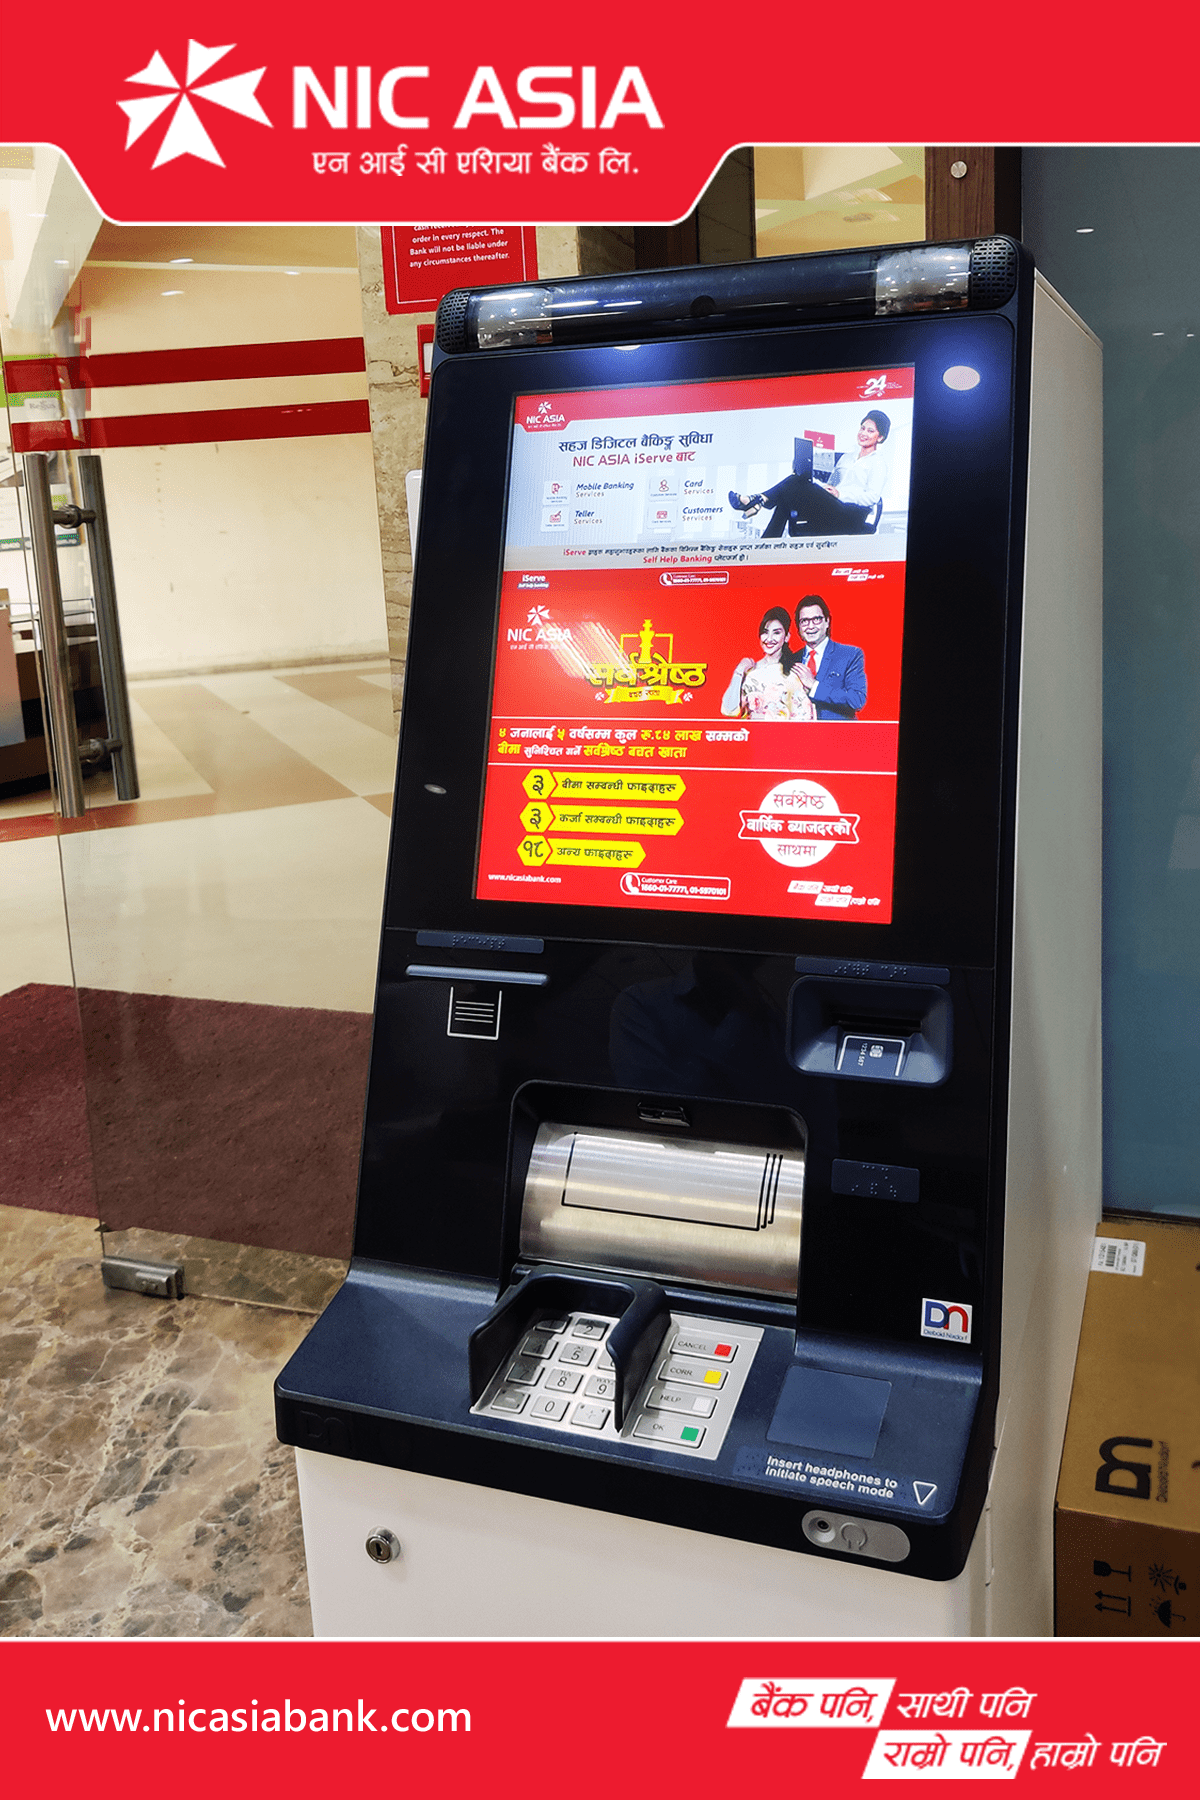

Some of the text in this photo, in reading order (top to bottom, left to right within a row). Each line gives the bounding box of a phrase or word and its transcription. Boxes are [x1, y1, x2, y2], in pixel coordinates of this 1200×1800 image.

[412, 228, 505, 243] order in every respect. The
[410, 240, 509, 256] Bank will not be liable under
[409, 251, 511, 268] any circumstances thereafter.
[526, 413, 566, 424] NIC ASIA
[558, 440, 588, 452] सहज
[591, 435, 637, 450] डिजिटल
[678, 431, 714, 448] सुविधा
[573, 451, 697, 467] NIC ASIA iServe बाट
[576, 482, 635, 491] Mobile Banking
[684, 479, 704, 488] Card
[683, 487, 714, 495] Services
[574, 510, 595, 518] Teller
[682, 506, 723, 515] Customers
[563, 548, 586, 556] iServe
[660, 555, 679, 563] Help
[680, 555, 713, 563] Banking
[522, 574, 546, 582] iServe
[507, 628, 574, 642] NIC ASIA
[585, 652, 708, 688] सर्वश्रेष्ठ
[499, 728, 507, 738] ४
[510, 725, 557, 741] जनालाई
[569, 725, 613, 740] वर्षसम्म
[614, 729, 638, 744] कुल
[674, 730, 703, 741] लाख
[705, 727, 750, 742] सम्मको
[497, 740, 521, 754] बीमा
[583, 742, 626, 757] सर्वश्रेष्ठ
[628, 746, 655, 758] बचत
[658, 746, 688, 758] खाता
[532, 775, 544, 796] ३
[561, 777, 583, 789] बीमा
[586, 778, 623, 791] सम्बन्धी
[773, 789, 827, 809] सर्वश्रेष्ठ
[529, 808, 542, 830] ३
[559, 812, 583, 823] कर्जा
[584, 813, 623, 825] सम्बन्धी
[746, 814, 852, 836] वार्षिक ब्याजदरको
[523, 840, 544, 858] १८
[556, 847, 582, 857] अन्य
[777, 843, 818, 856] साथमा
[487, 873, 562, 884] www.nicasiabank.com
[583, 1325, 593, 1335] 2
[677, 1341, 707, 1351] CANCEL
[571, 1350, 580, 1360] 5
[670, 1367, 693, 1376] CORR
[557, 1376, 567, 1387] 8
[597, 1384, 607, 1395] 9
[660, 1394, 682, 1402] HELP
[544, 1400, 555, 1412] 0
[652, 1423, 665, 1431] OK
[767, 1455, 898, 1489] Insert headphones to
[765, 1465, 894, 1499] initiate speech mode
